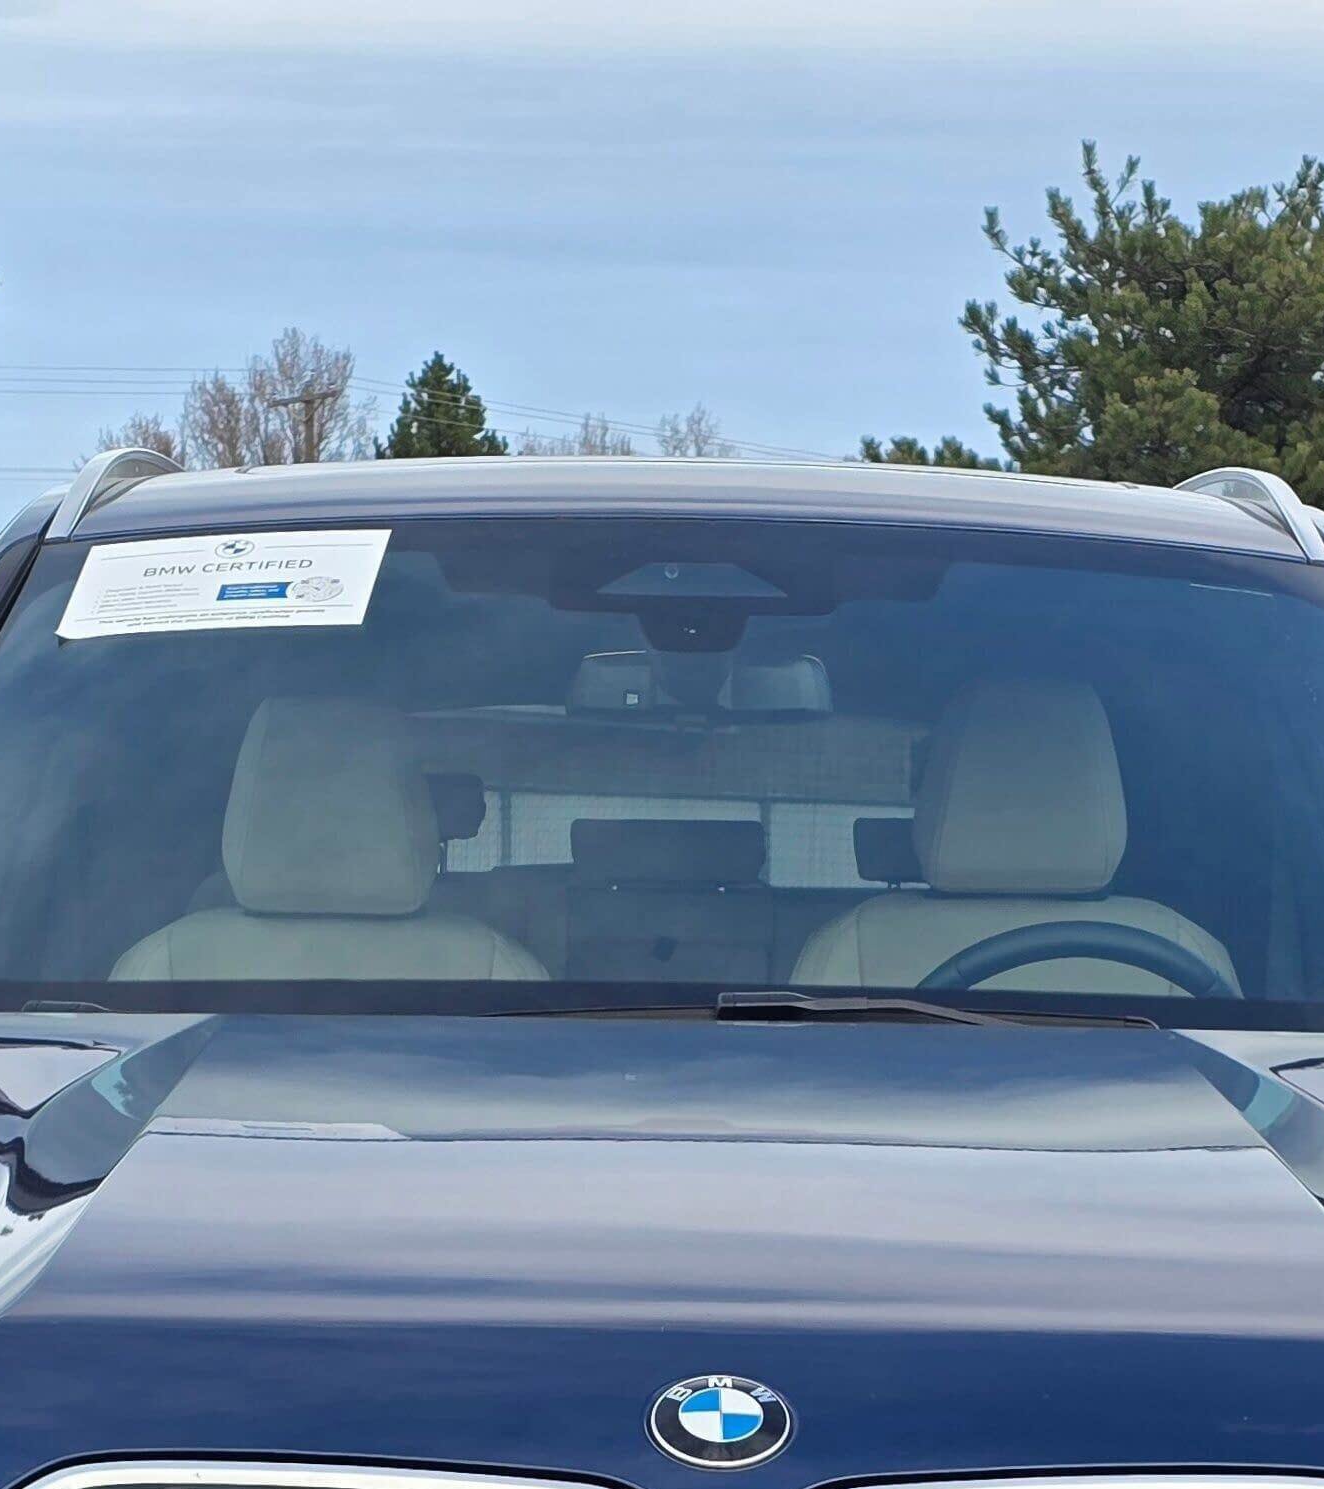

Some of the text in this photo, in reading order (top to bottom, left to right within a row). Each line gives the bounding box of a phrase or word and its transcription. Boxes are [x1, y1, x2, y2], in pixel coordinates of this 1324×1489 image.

[143, 559, 313, 578] BMW CERTIFIED
[666, 1376, 777, 1402] BMW
